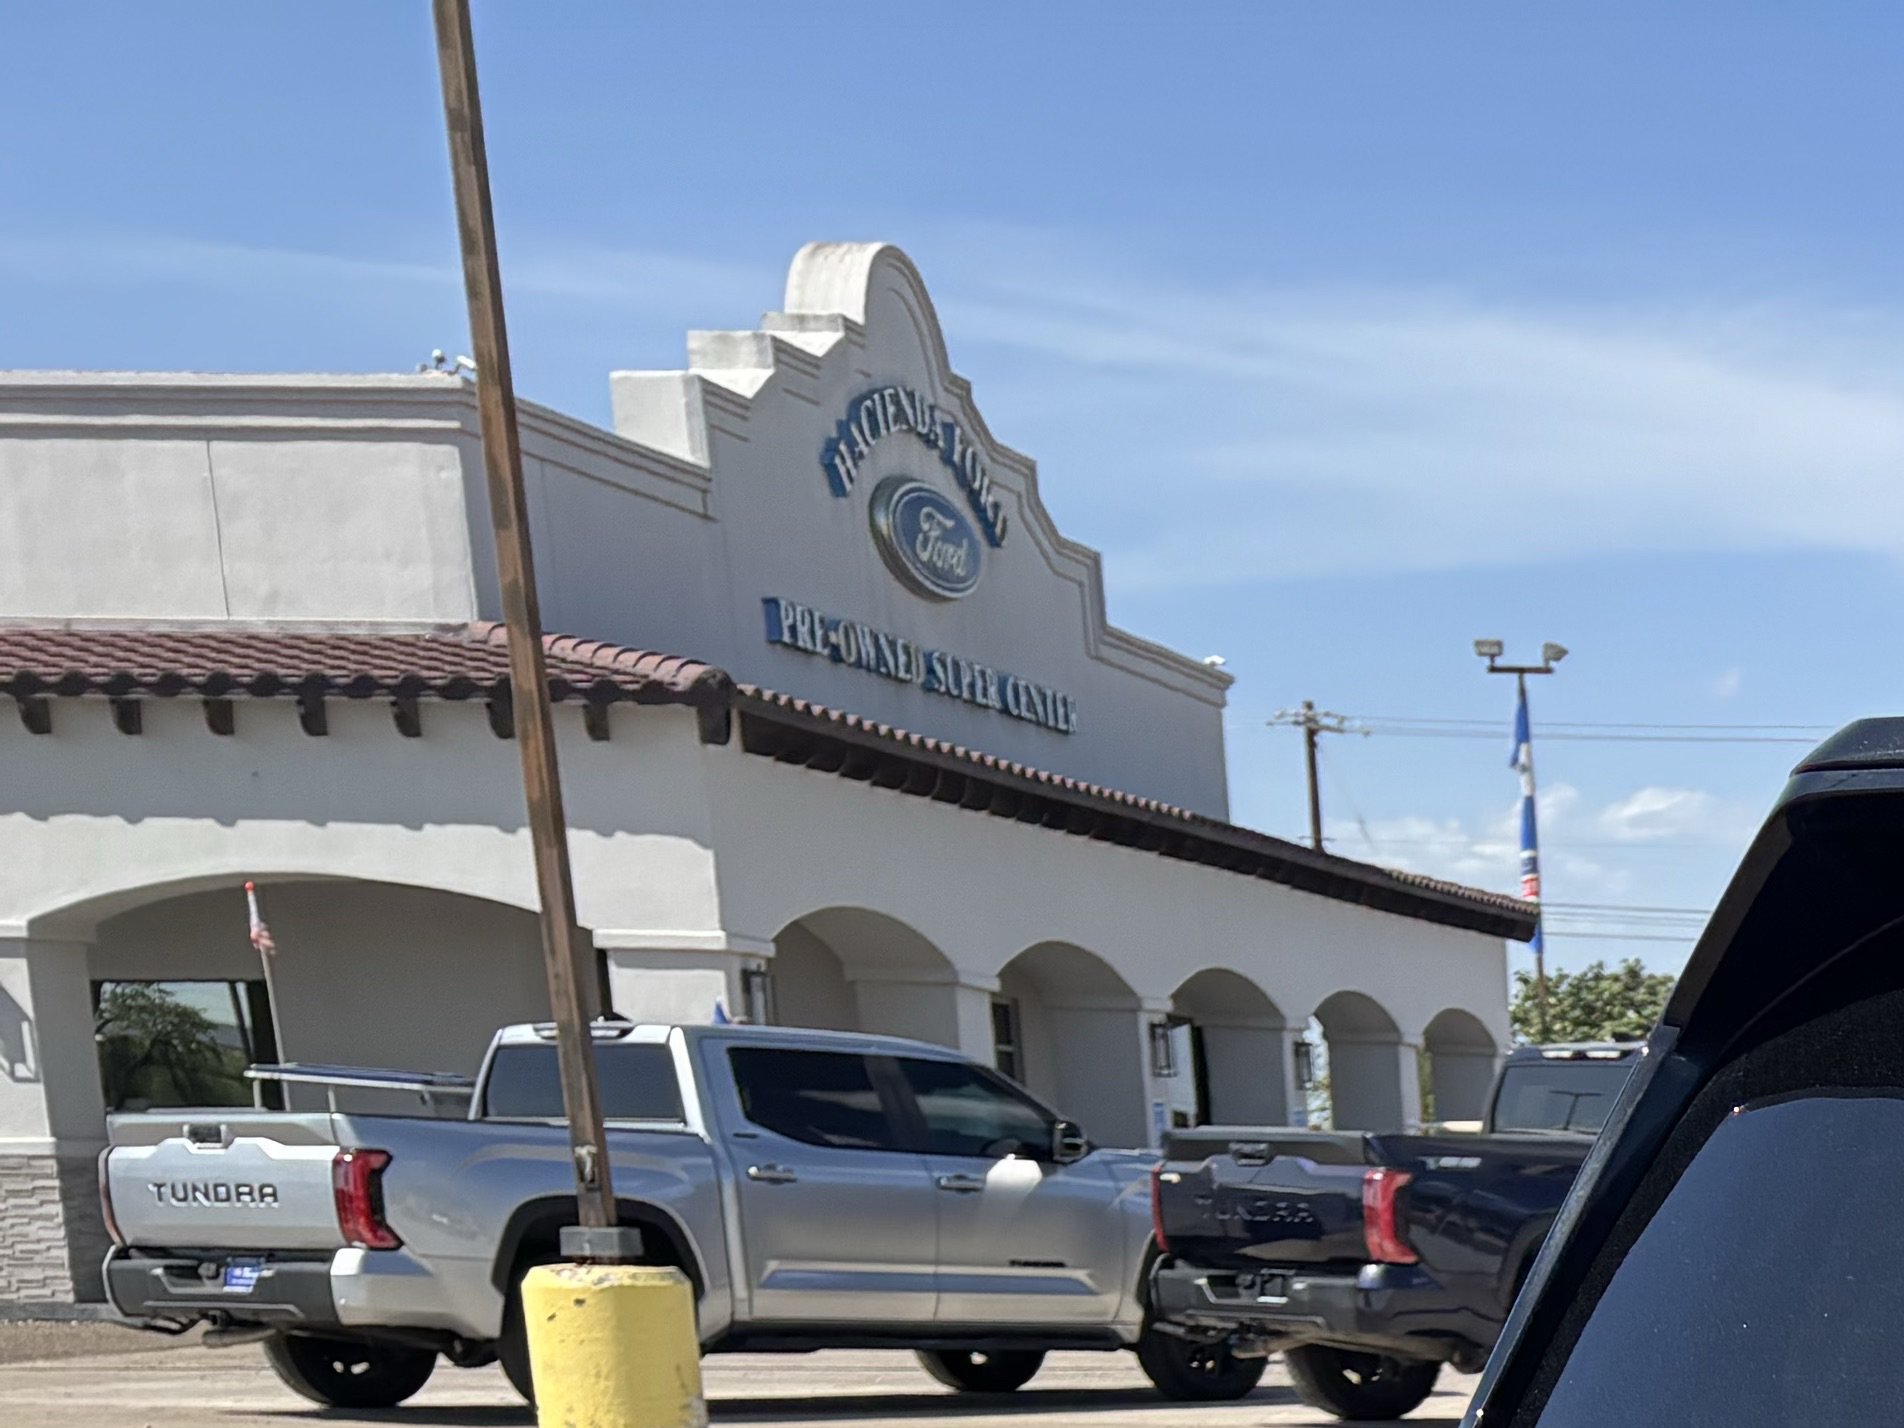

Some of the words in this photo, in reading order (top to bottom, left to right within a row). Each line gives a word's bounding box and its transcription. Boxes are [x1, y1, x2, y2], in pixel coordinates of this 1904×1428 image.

[832, 386, 946, 494] HACIENDA
[916, 506, 969, 577] Ford
[778, 600, 926, 685] PRE-OWNED
[931, 650, 1001, 709] SUPER
[1004, 674, 1078, 735] CENTER
[150, 1181, 280, 1207] TUNDRA
